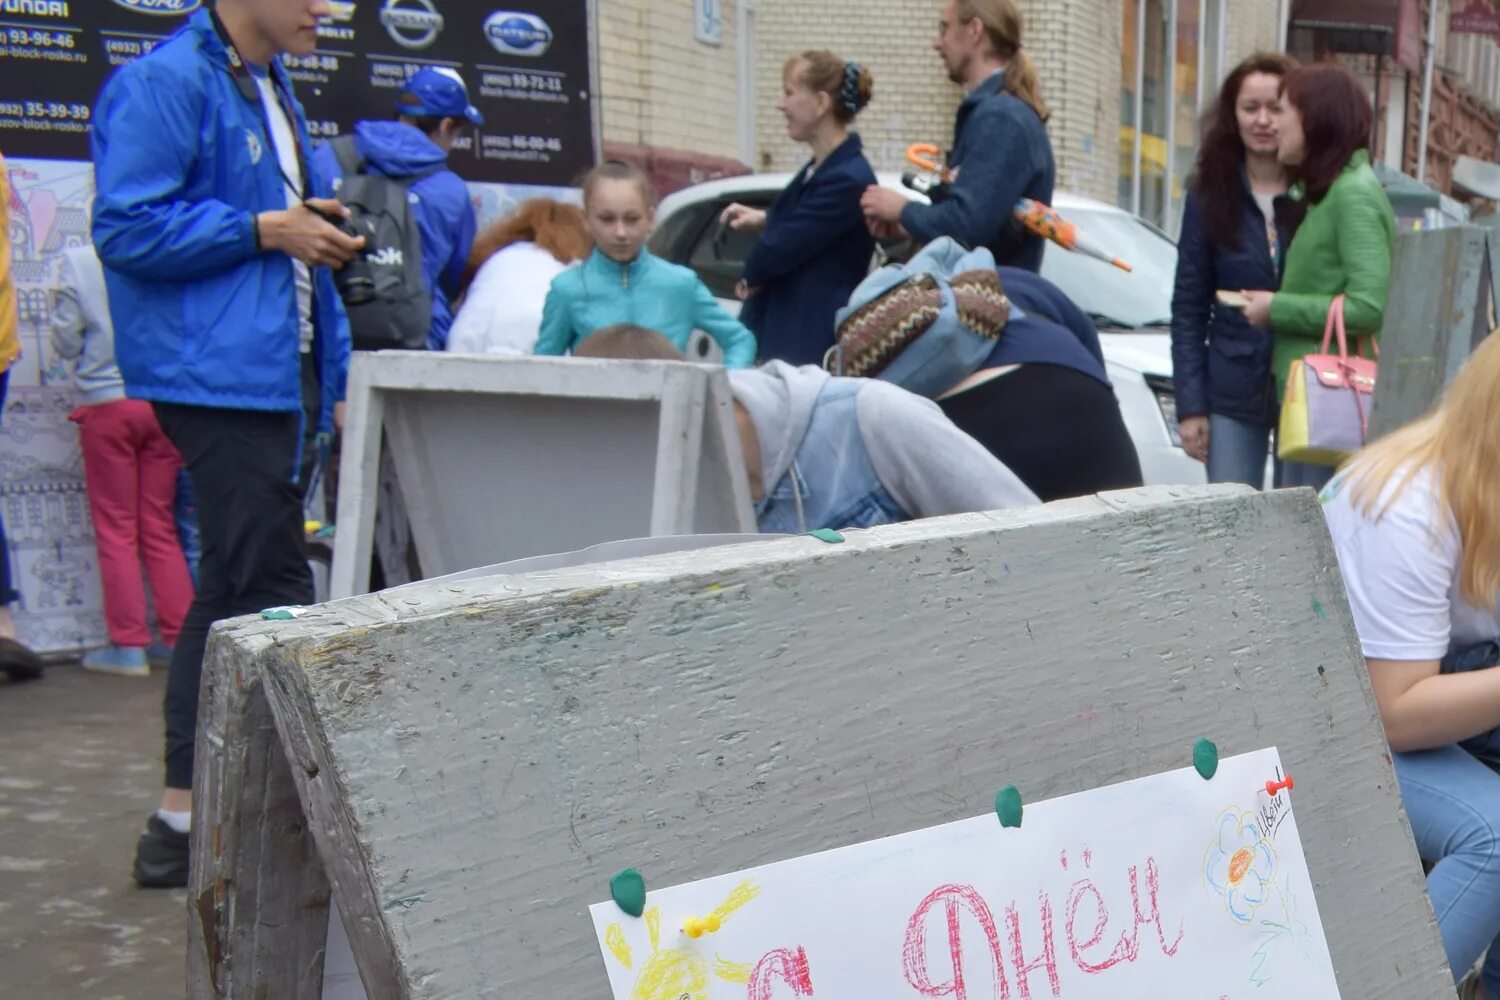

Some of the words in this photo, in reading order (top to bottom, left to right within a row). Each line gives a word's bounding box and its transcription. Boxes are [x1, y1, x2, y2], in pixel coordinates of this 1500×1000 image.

[9, 28, 76, 48] 93-96-46
[106, 40, 141, 55] (4932)
[25, 101, 90, 120] 35-39-39
